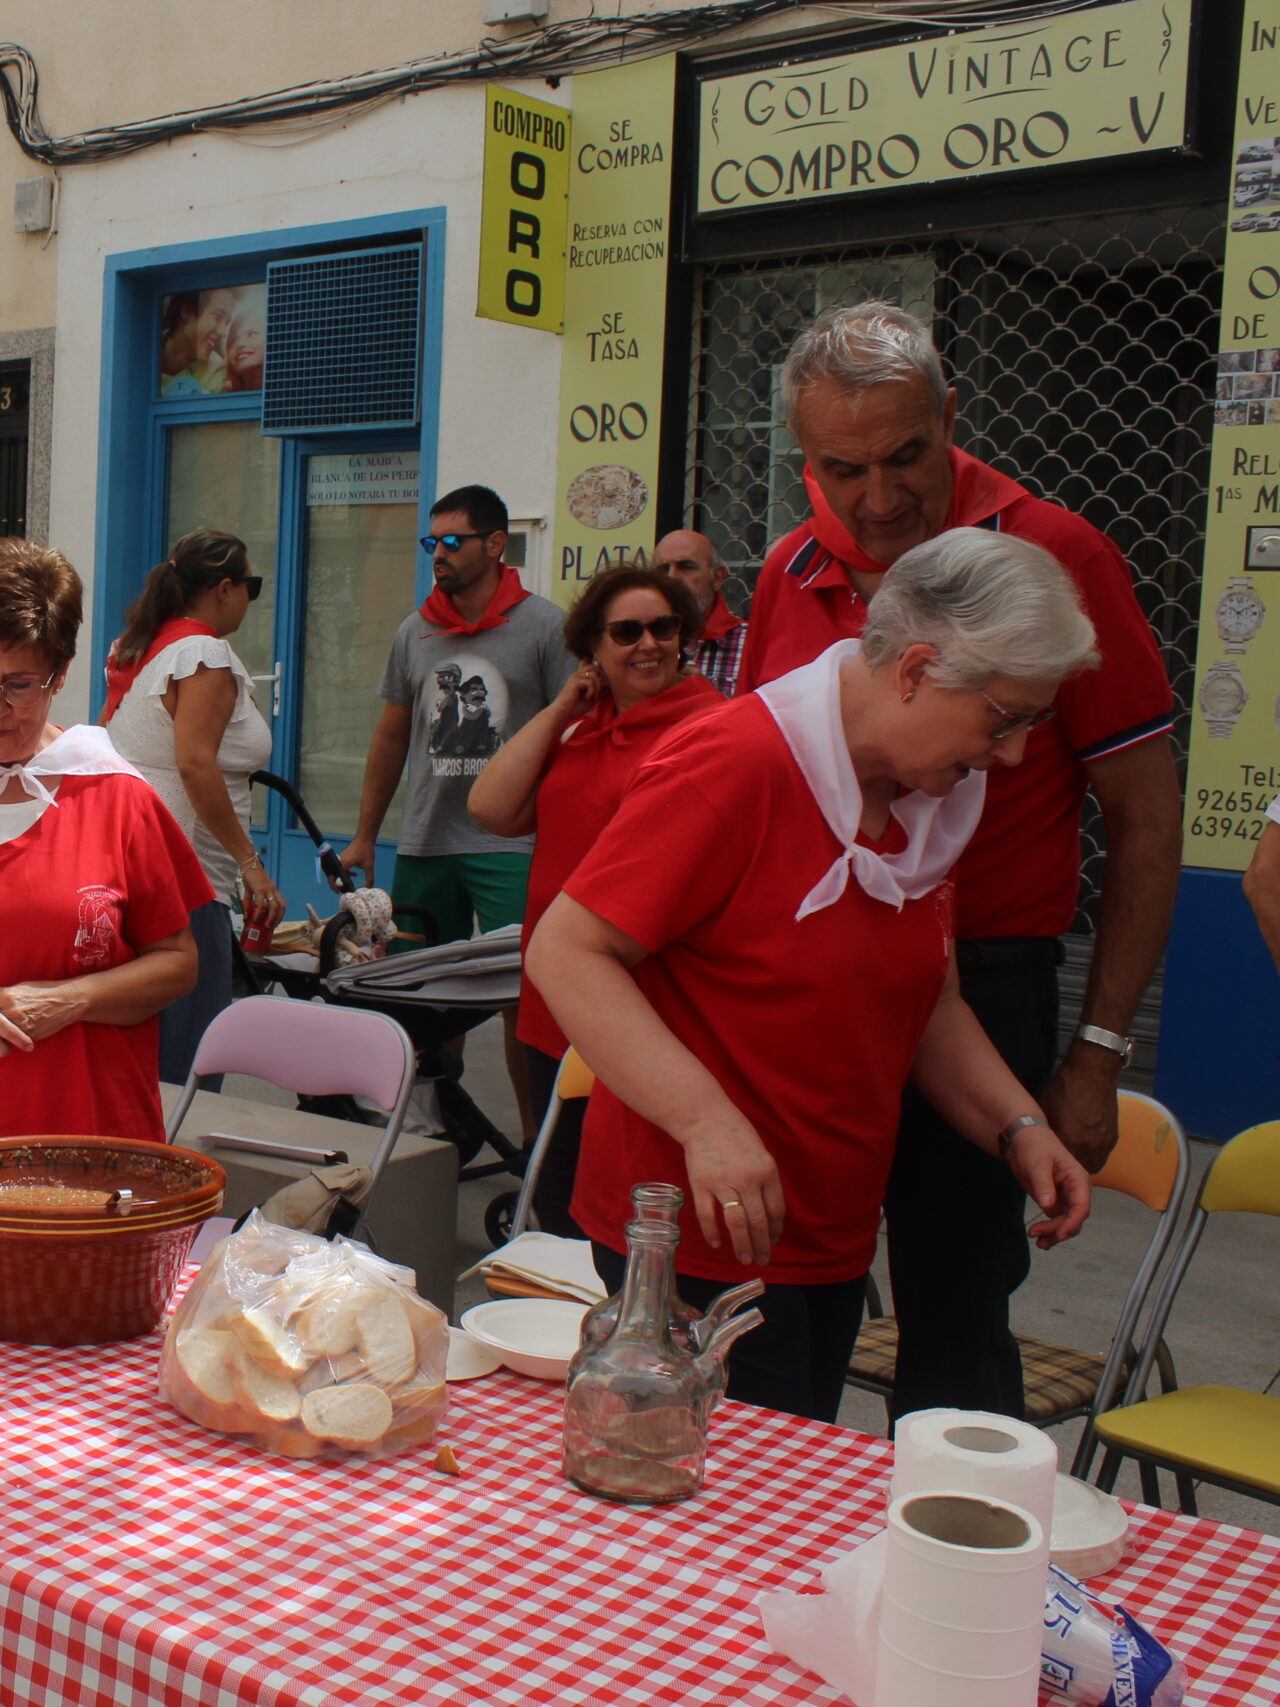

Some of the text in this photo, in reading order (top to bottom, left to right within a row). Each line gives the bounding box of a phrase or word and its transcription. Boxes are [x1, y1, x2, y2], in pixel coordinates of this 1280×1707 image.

[1251, 20, 1280, 51] IN
[744, 29, 1126, 126] GOLD VINTAGE
[493, 100, 565, 152] COMPRO
[609, 119, 633, 142] SE
[577, 141, 664, 174] COMPRA
[711, 133, 920, 204] COMPRO
[943, 110, 1069, 169] ORO
[505, 150, 546, 317] ORO
[573, 217, 663, 242] RESERVA CON
[601, 312, 625, 335] SE
[1233, 313, 1269, 340] DE
[586, 332, 639, 362] TASA
[0, 387, 12, 409] 3
[570, 402, 648, 443] ORO
[1232, 447, 1280, 476] REL
[1253, 484, 1280, 513] M
[561, 545, 649, 581] PLATA
[1197, 789, 1278, 813] 92654
